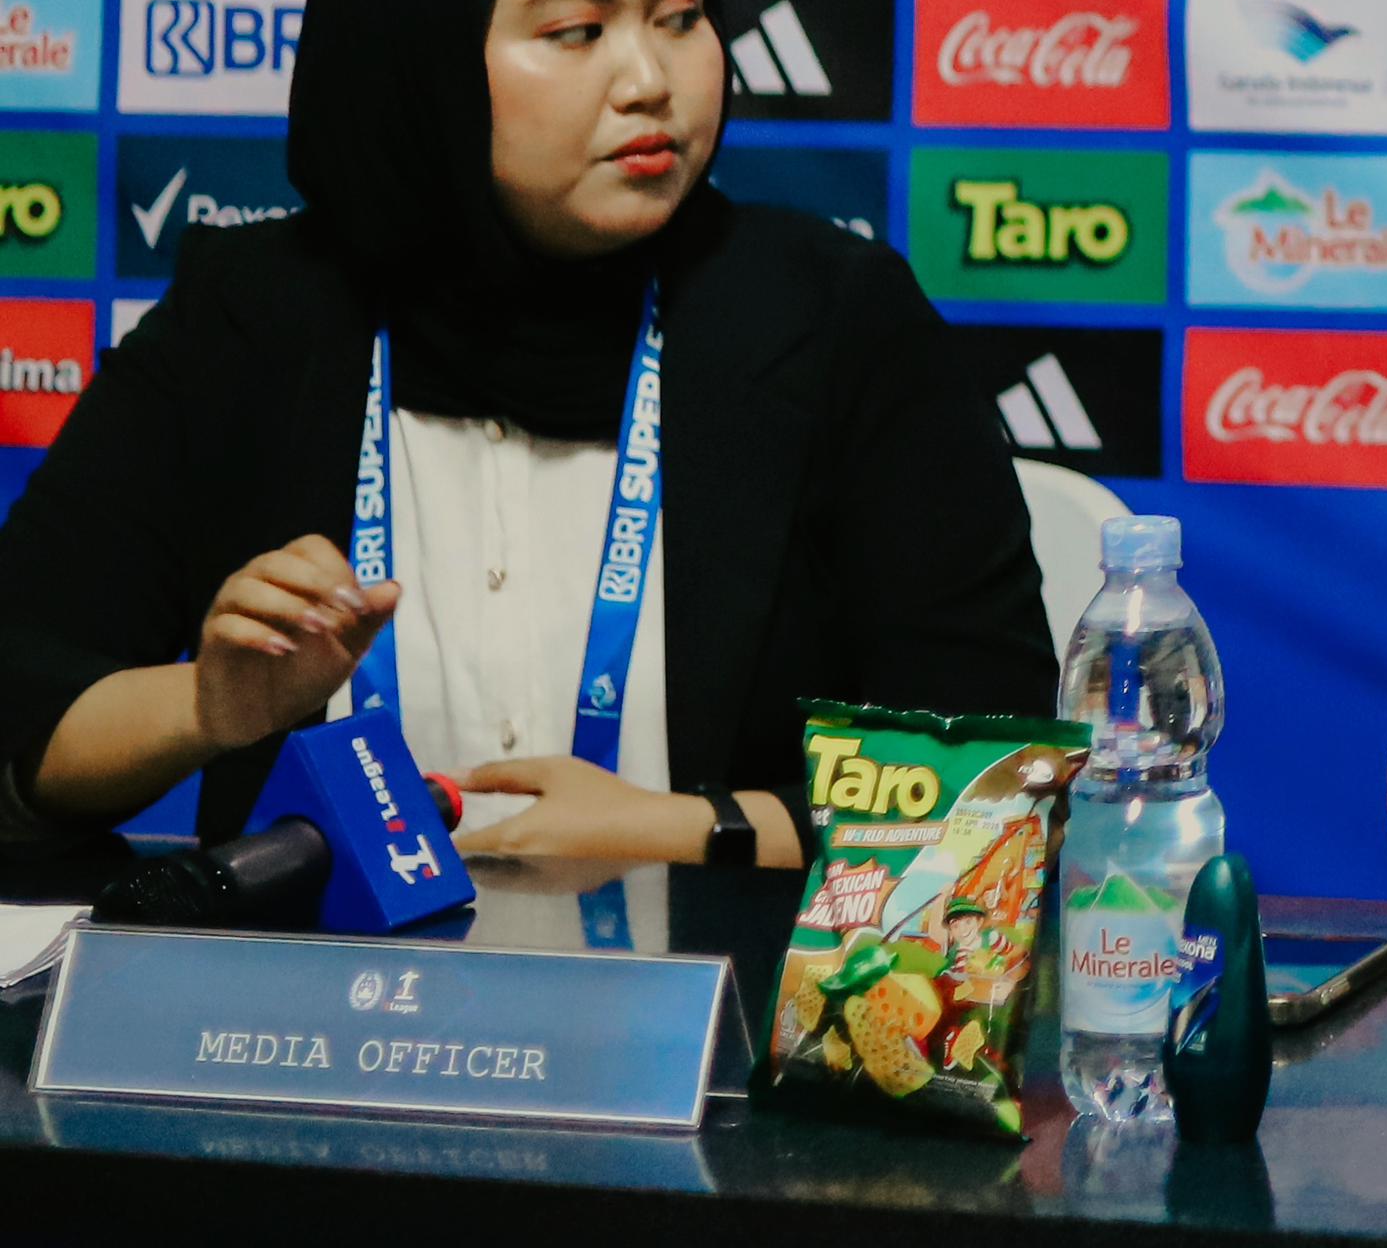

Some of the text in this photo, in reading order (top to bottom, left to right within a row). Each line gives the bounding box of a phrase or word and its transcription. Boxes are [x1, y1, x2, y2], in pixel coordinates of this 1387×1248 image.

[953, 181, 1129, 262] Taro
[1325, 189, 1371, 230] Le
[354, 528, 386, 582] BRI
[609, 507, 650, 564] BRI
[807, 735, 941, 818] Taro
[885, 824, 944, 843] ADVENTURE
[1072, 950, 1176, 980] Minerale
[1101, 928, 1131, 955] Le
[195, 1031, 547, 1081] MEDIA OFFICER
